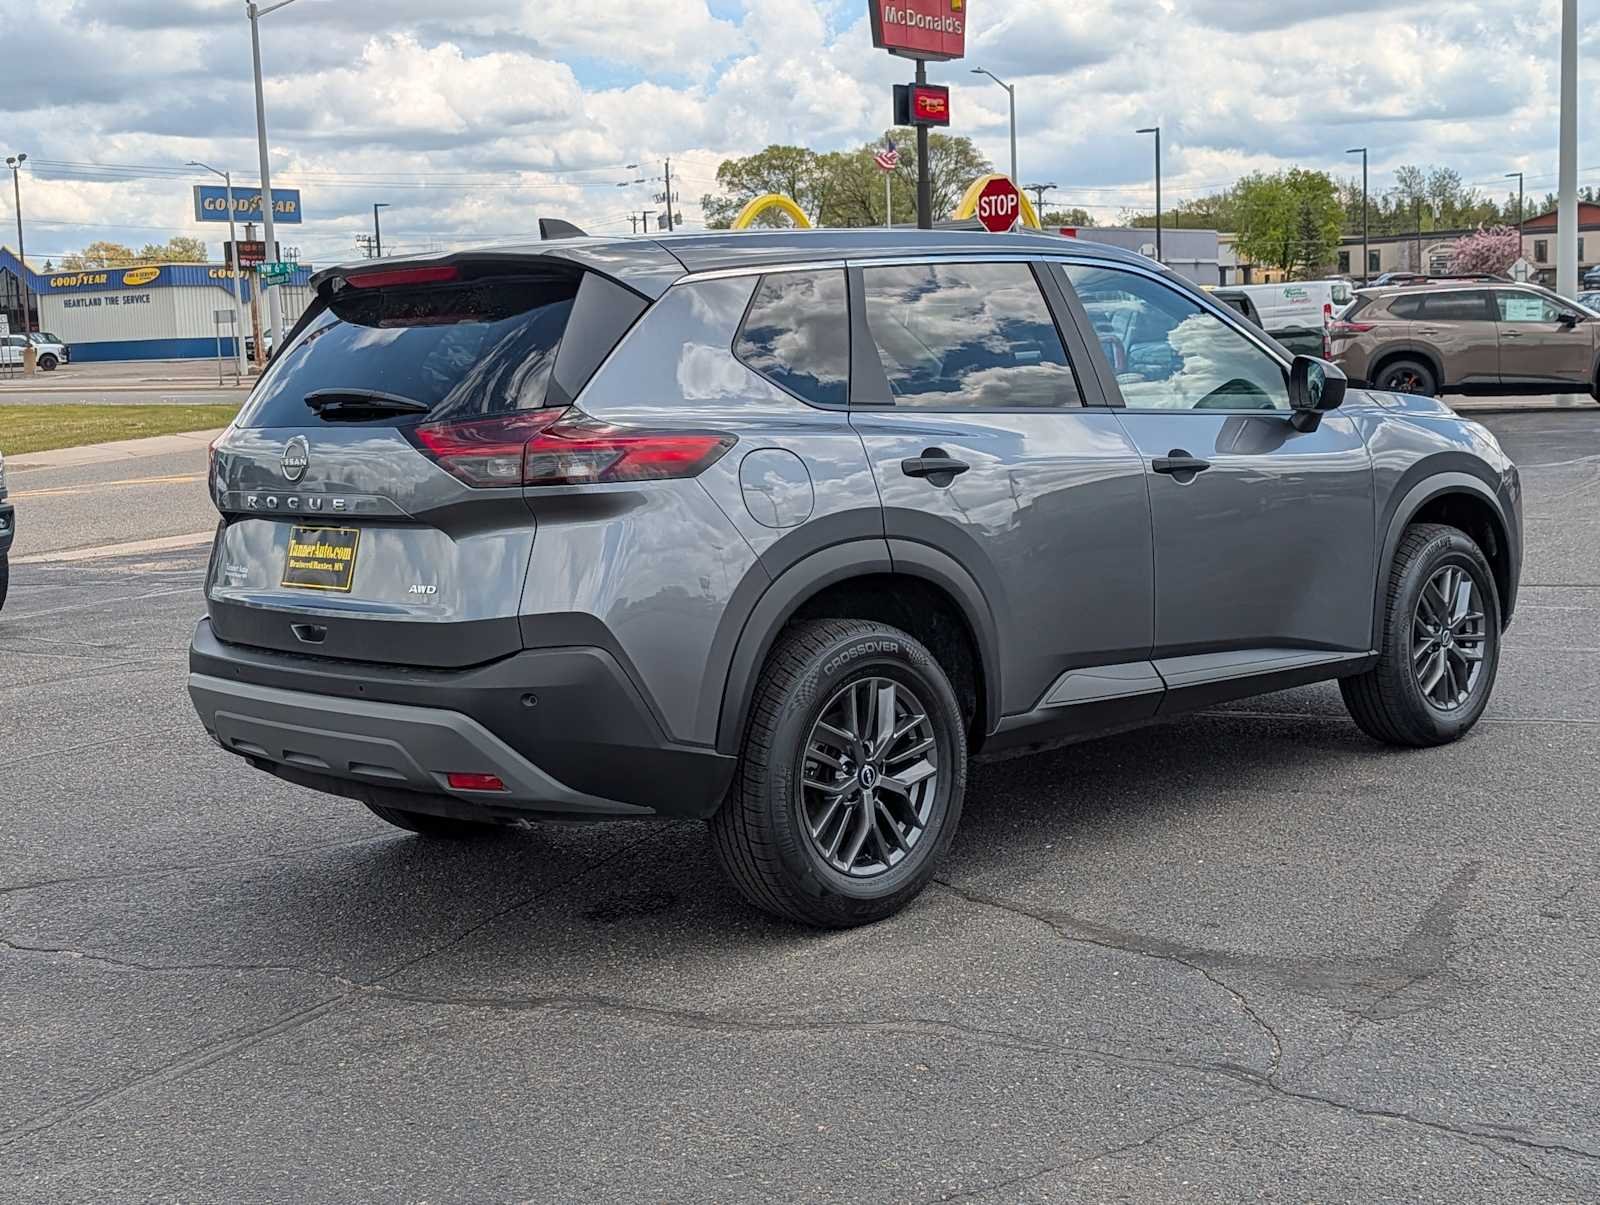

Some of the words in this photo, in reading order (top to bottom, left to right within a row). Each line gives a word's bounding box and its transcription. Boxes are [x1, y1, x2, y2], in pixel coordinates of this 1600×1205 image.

[884, 6, 962, 34] McDonald's
[980, 193, 1017, 217] STOP
[261, 264, 272, 273] NW
[51, 274, 107, 287] GOODYEAR
[63, 297, 102, 308] HEARTLAND
[104, 296, 119, 306] TIRE
[122, 294, 151, 305] SERVICE
[247, 496, 346, 511] ROGUE
[289, 540, 352, 560] TannerAuto.com
[408, 585, 437, 594] AWD
[824, 641, 899, 675] CROSSOVER
